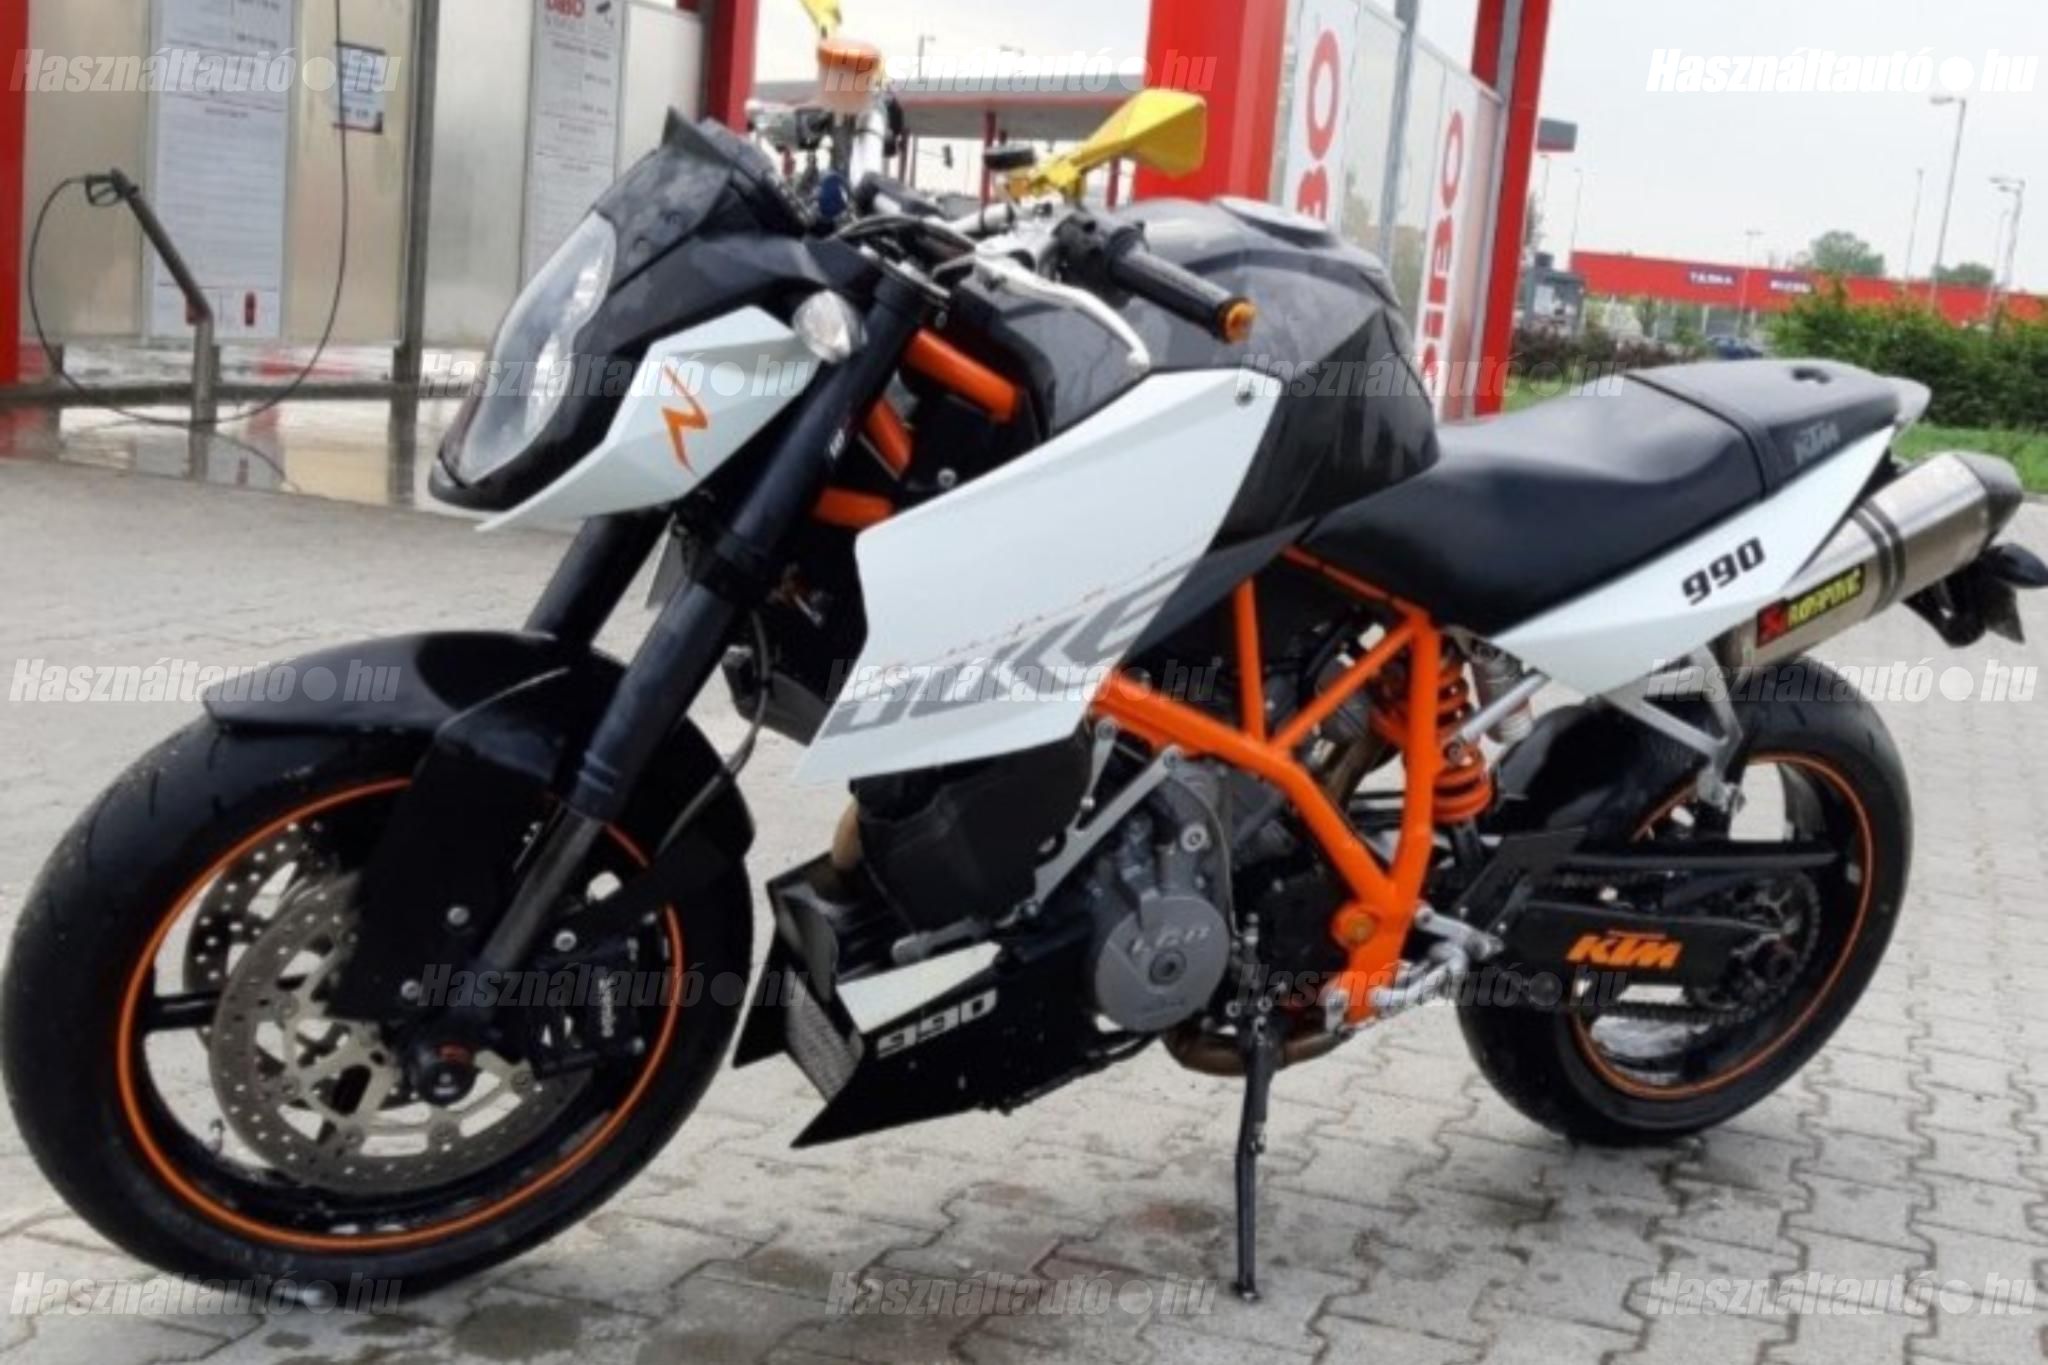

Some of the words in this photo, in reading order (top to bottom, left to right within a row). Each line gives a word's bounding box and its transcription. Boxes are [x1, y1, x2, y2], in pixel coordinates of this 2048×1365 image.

[1681, 537, 1766, 606] 990
[1565, 930, 1682, 969] KTM
[877, 986, 997, 1060] 990
